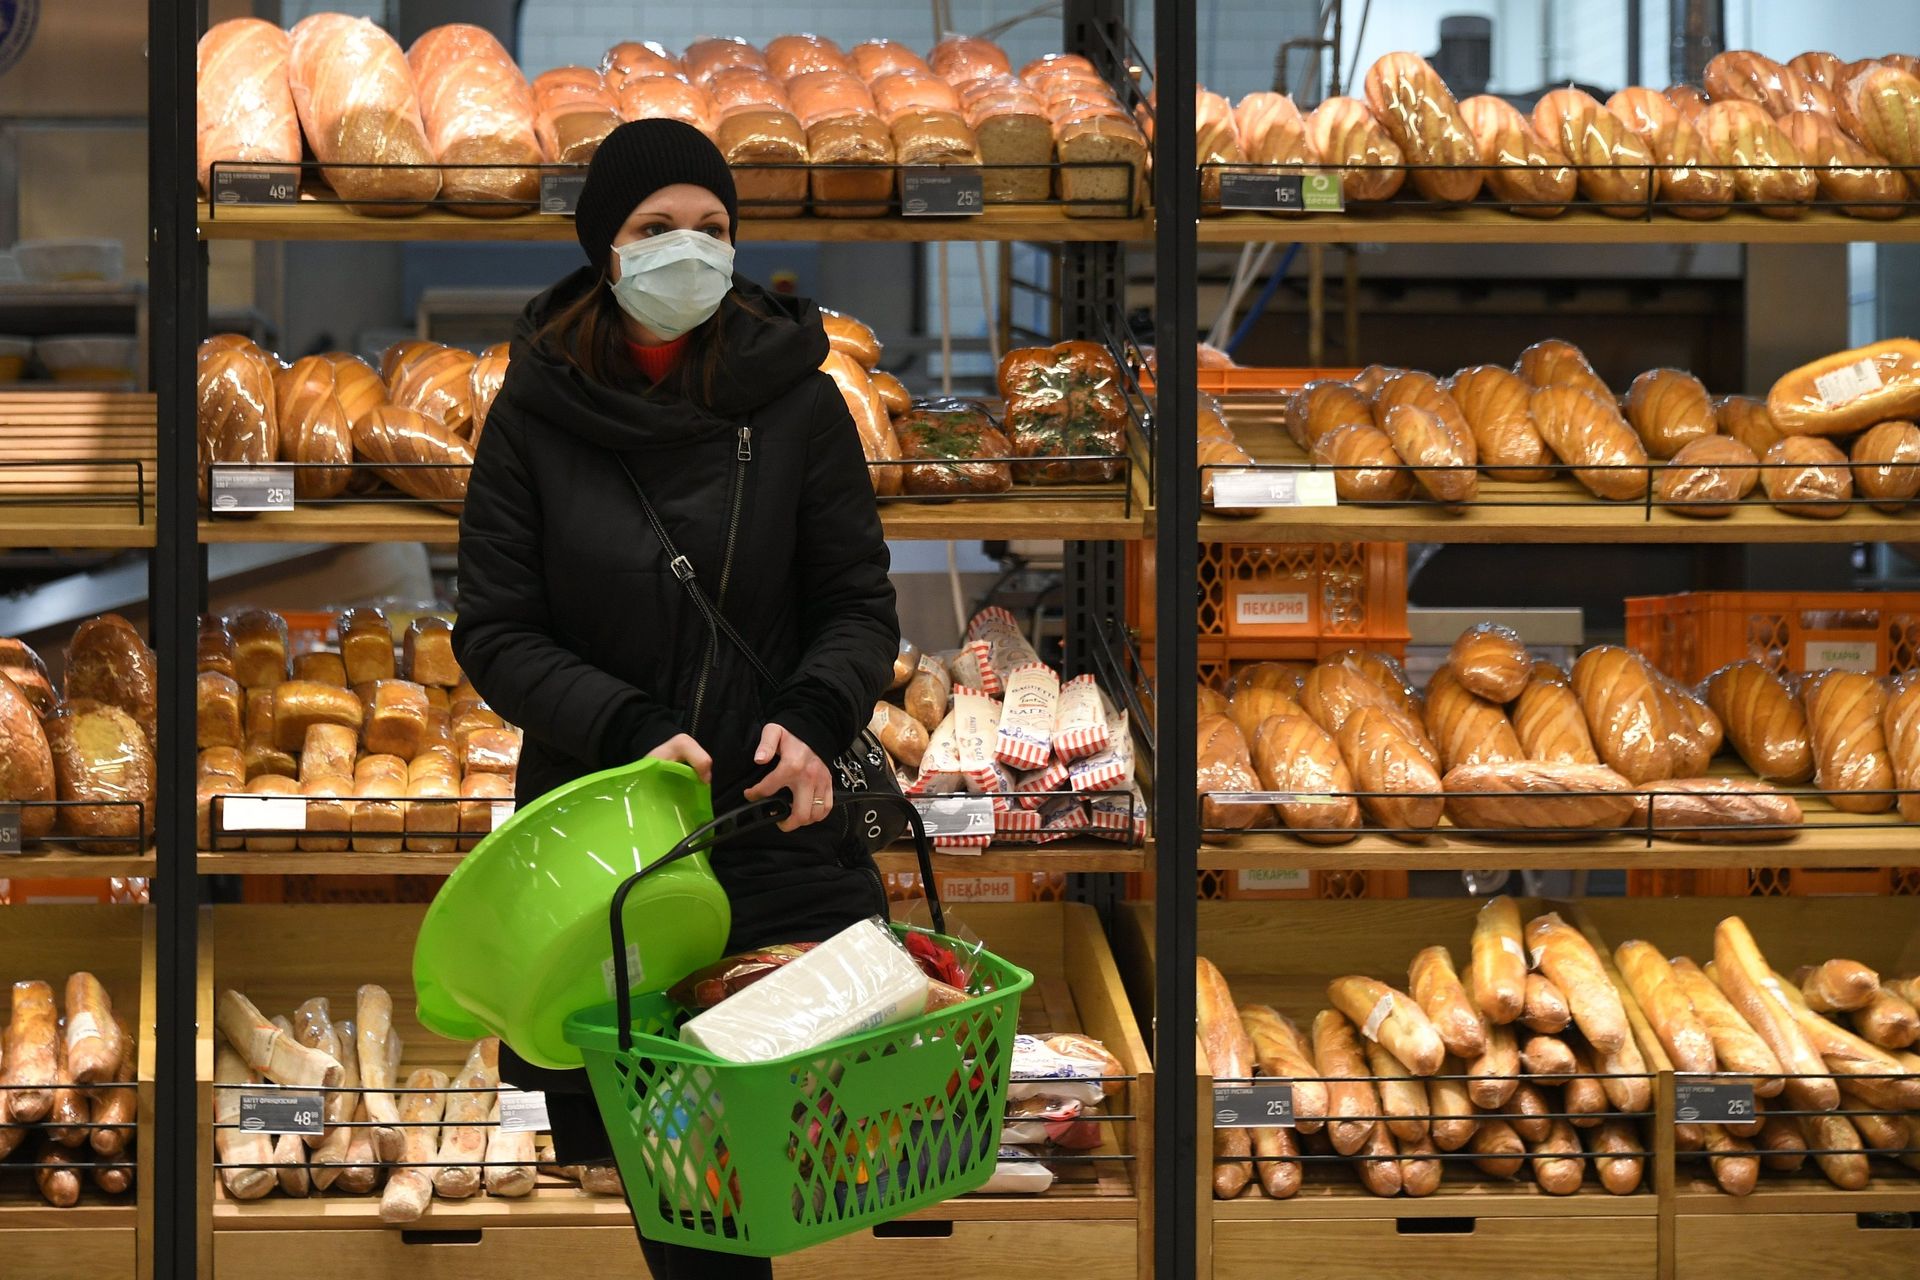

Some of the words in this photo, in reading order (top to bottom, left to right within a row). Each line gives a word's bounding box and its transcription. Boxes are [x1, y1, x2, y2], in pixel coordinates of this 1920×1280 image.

[269, 184, 287, 200] 49
[957, 191, 973, 206] 25
[1274, 187, 1289, 202] 15
[267, 488, 283, 503] 25
[1269, 486, 1283, 499] 15
[1243, 602, 1303, 616] ПЕКАРНЯ
[967, 813, 982, 826] 73
[1248, 869, 1299, 881] ПЕКАРНЯ
[948, 883, 1008, 897] ПЕКАРНЯ
[1267, 1101, 1283, 1115] 25
[1728, 1099, 1745, 1115] 25
[294, 1111, 311, 1126] 48
